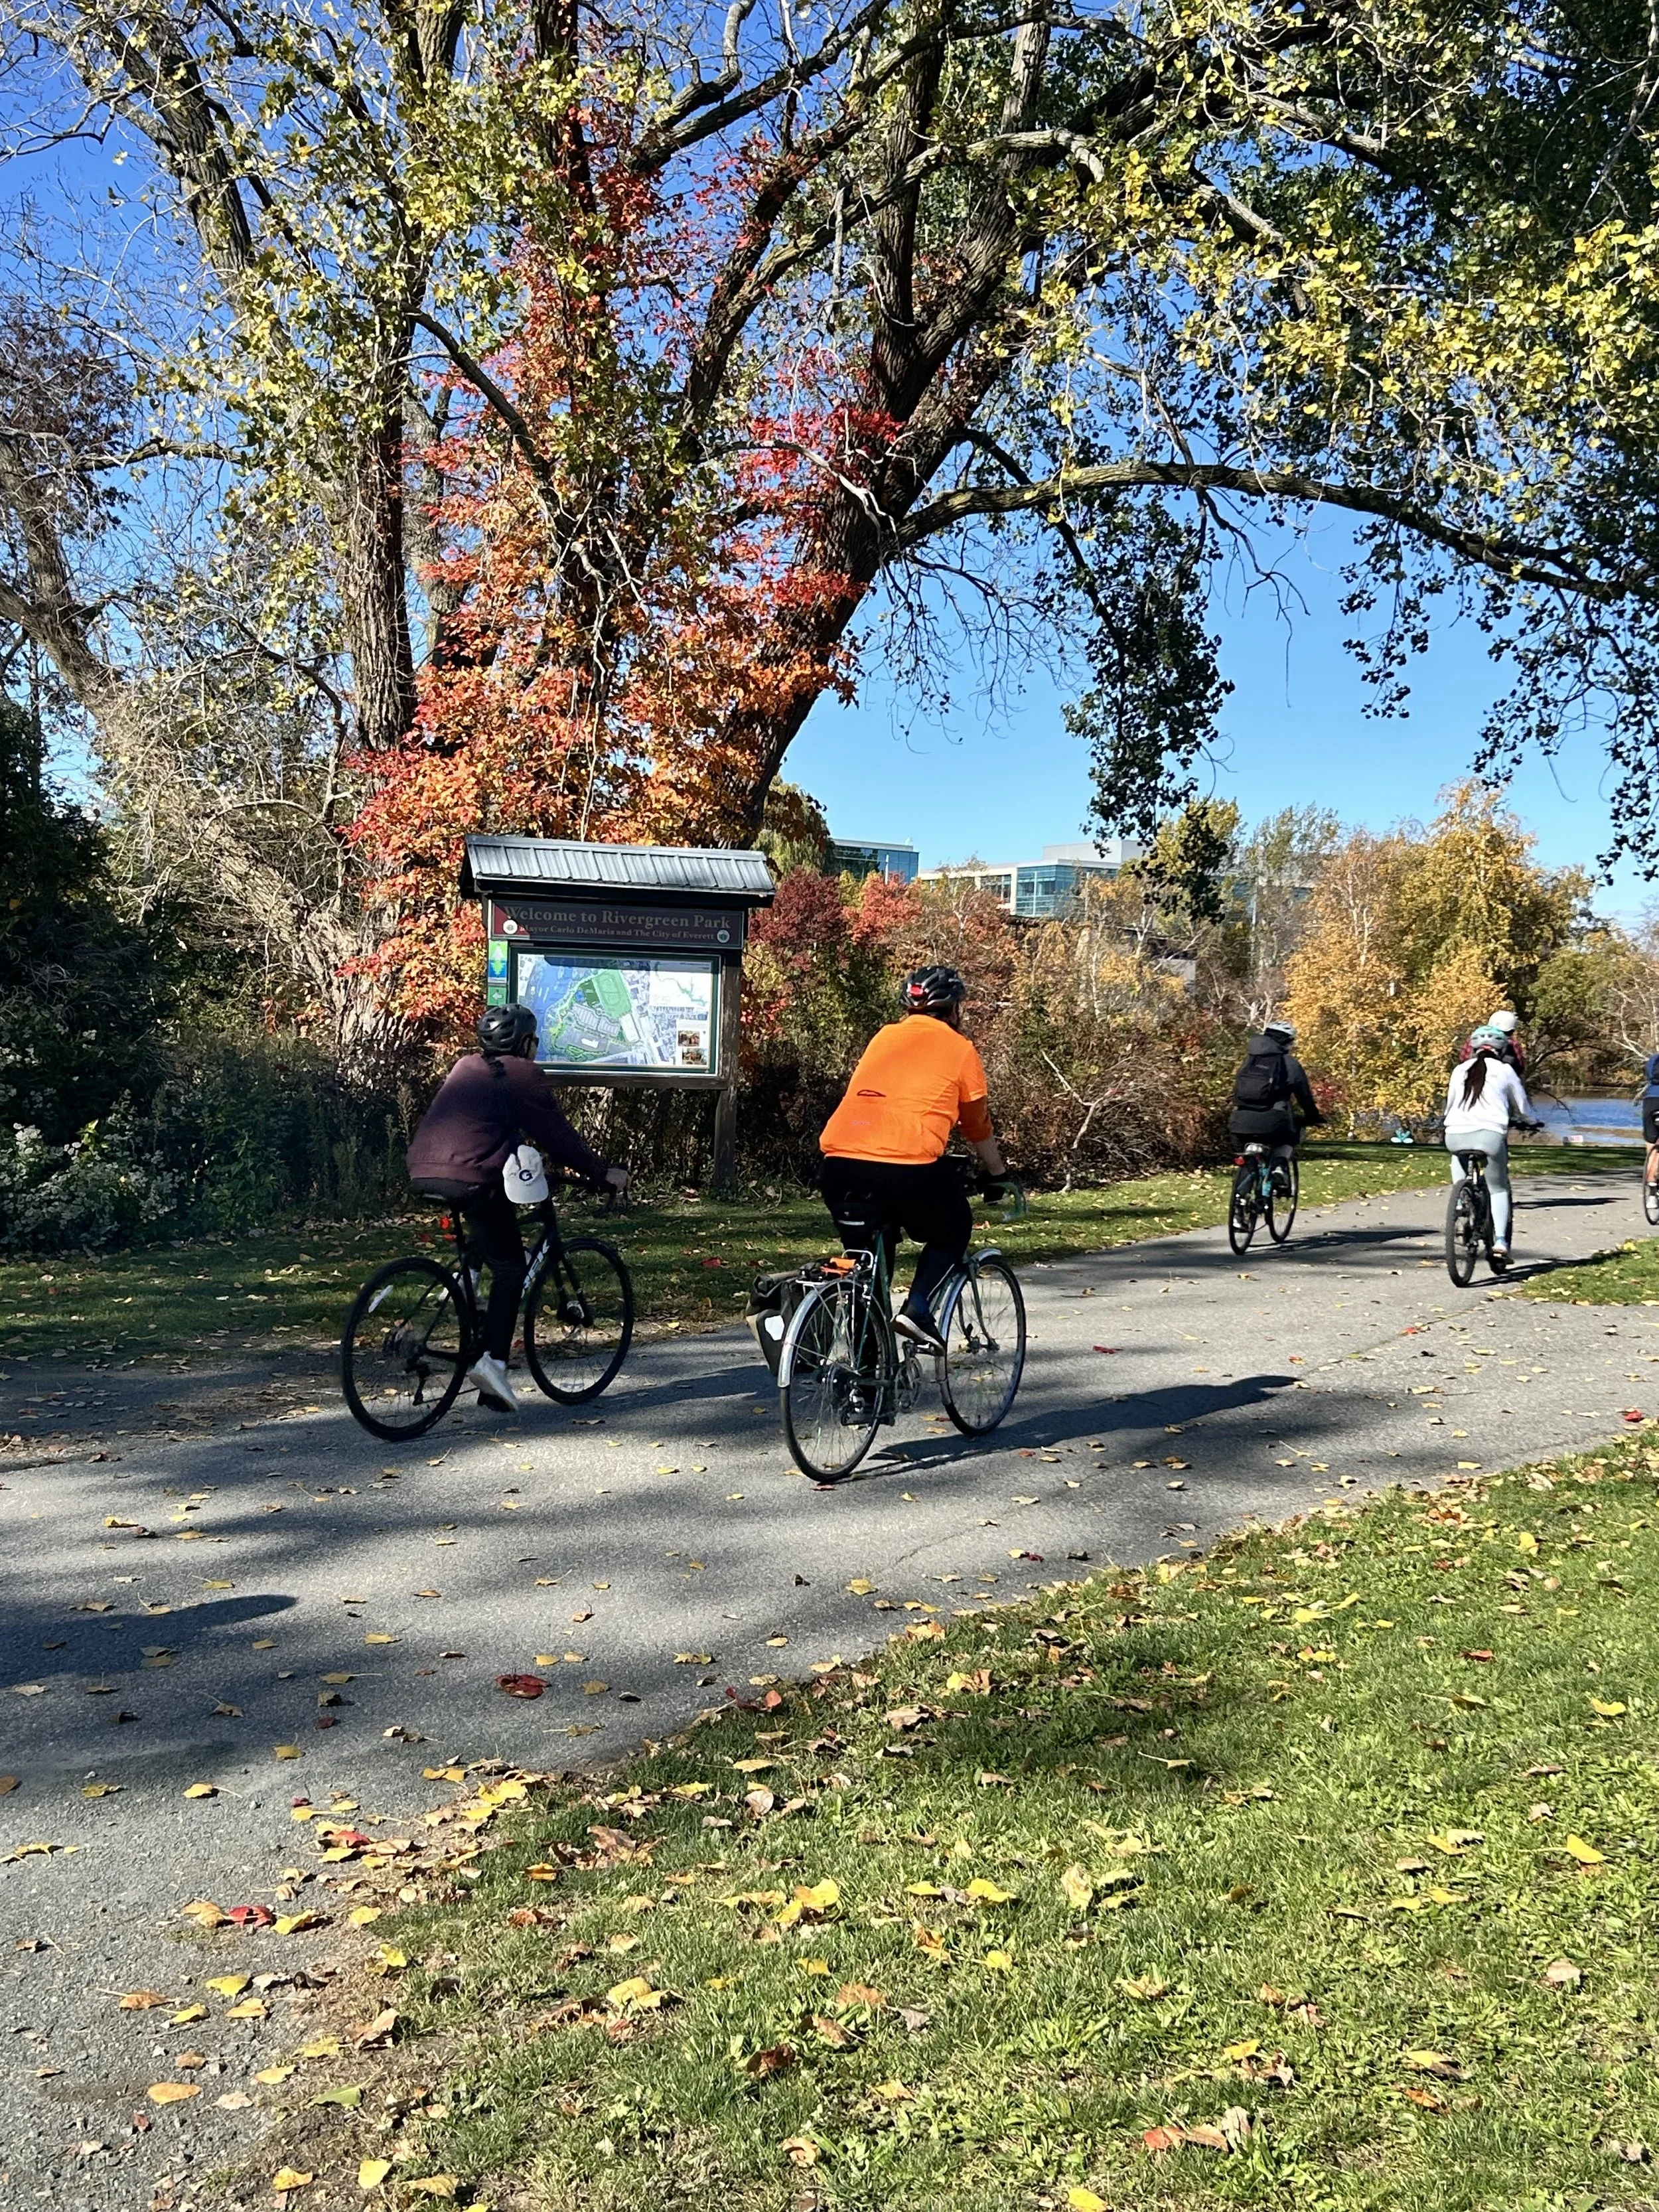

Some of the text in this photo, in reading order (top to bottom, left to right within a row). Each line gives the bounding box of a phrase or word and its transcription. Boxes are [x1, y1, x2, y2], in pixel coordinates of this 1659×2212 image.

[503, 906, 731, 929] Welcome to Rivergreen Park
[519, 925, 549, 934] Mayor
[577, 926, 614, 935] DeMaria
[652, 930, 670, 940] City
[518, 1169, 534, 1182] G
